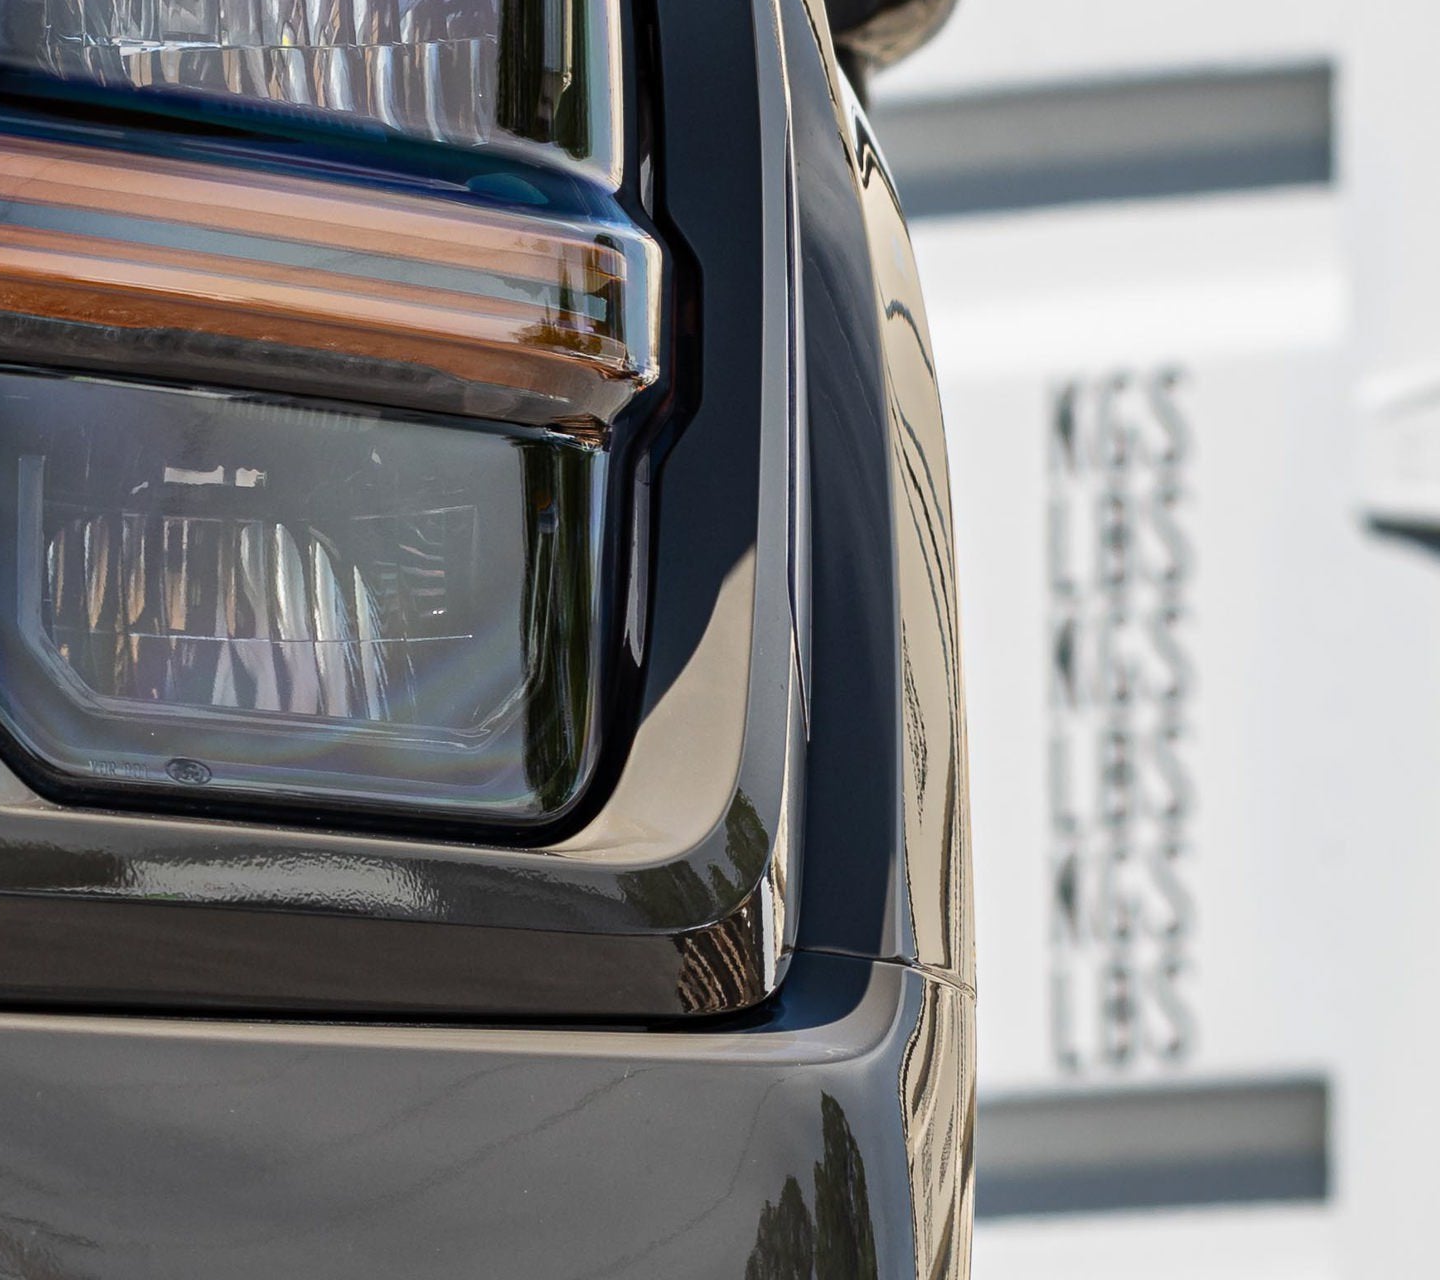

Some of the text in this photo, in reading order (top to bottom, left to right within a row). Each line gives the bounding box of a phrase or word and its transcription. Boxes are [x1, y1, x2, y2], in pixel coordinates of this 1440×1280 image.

[1045, 367, 1194, 475] KGS
[1045, 484, 1194, 598] LBS
[1045, 604, 1194, 711] KGS
[1045, 723, 1194, 834] LBS
[1045, 841, 1194, 947] KGS
[1045, 959, 1194, 1075] LBS
